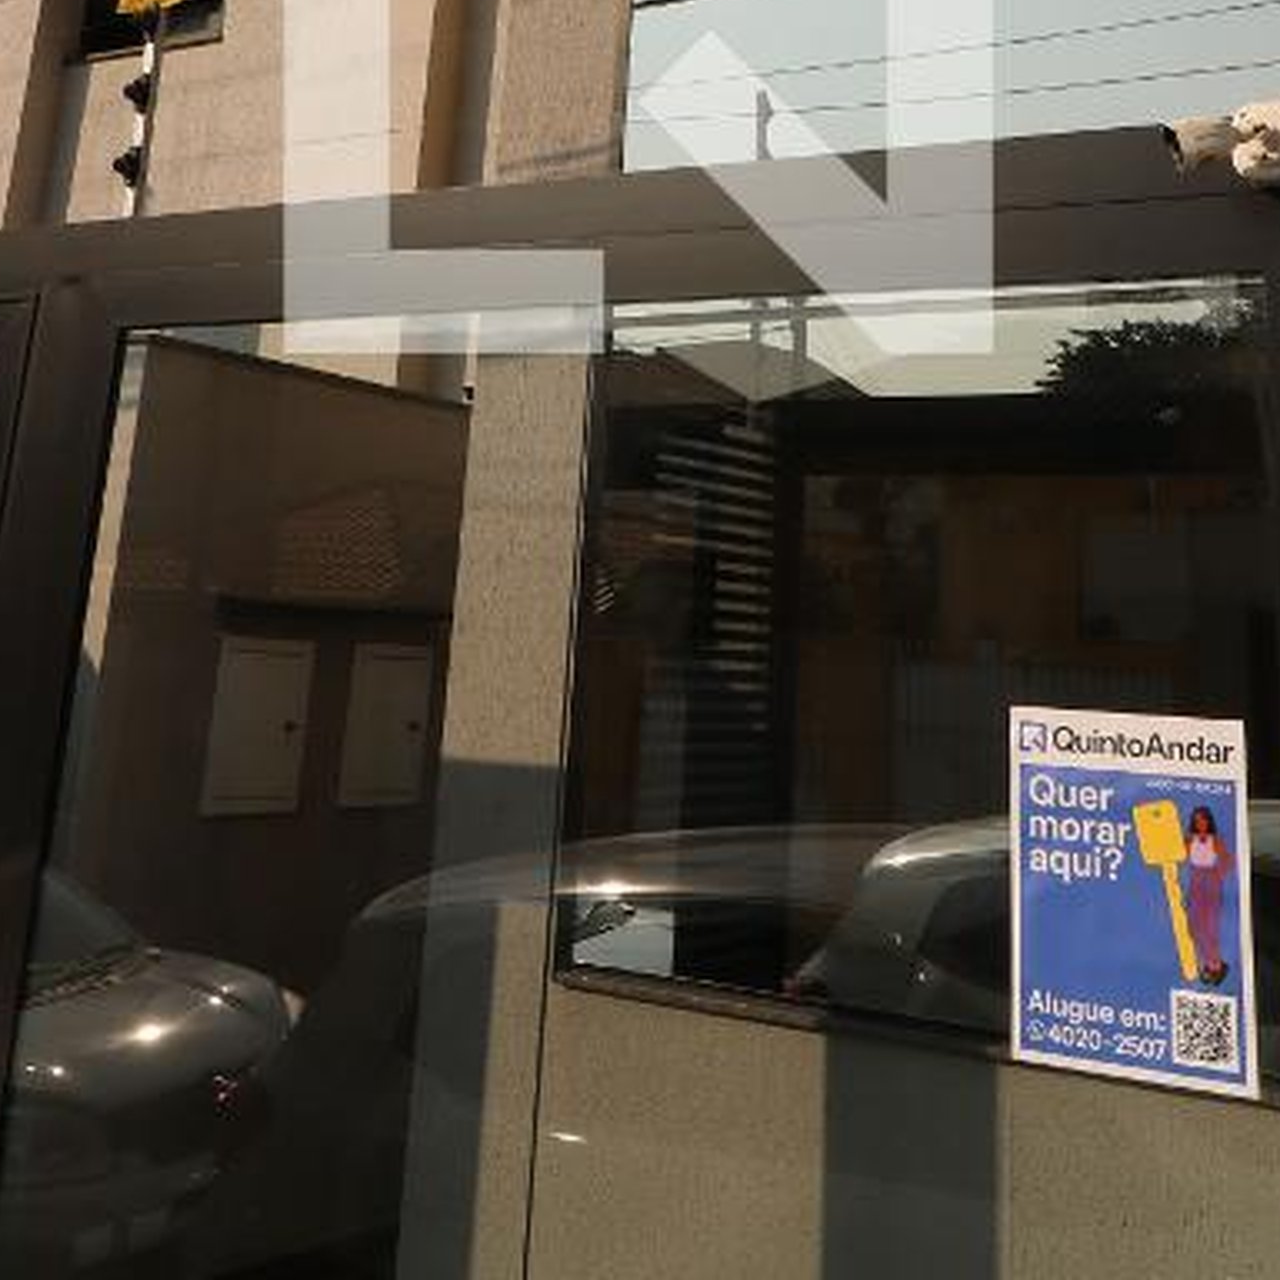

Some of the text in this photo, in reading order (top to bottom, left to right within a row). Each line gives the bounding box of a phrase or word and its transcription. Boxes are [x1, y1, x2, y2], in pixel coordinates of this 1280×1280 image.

[1052, 725, 1235, 764] QuintoAndar
[1028, 773, 1115, 811] Quer
[1029, 814, 1132, 846] morar
[1029, 847, 1123, 882] aqui?
[1027, 989, 1167, 1032] Alugue em:
